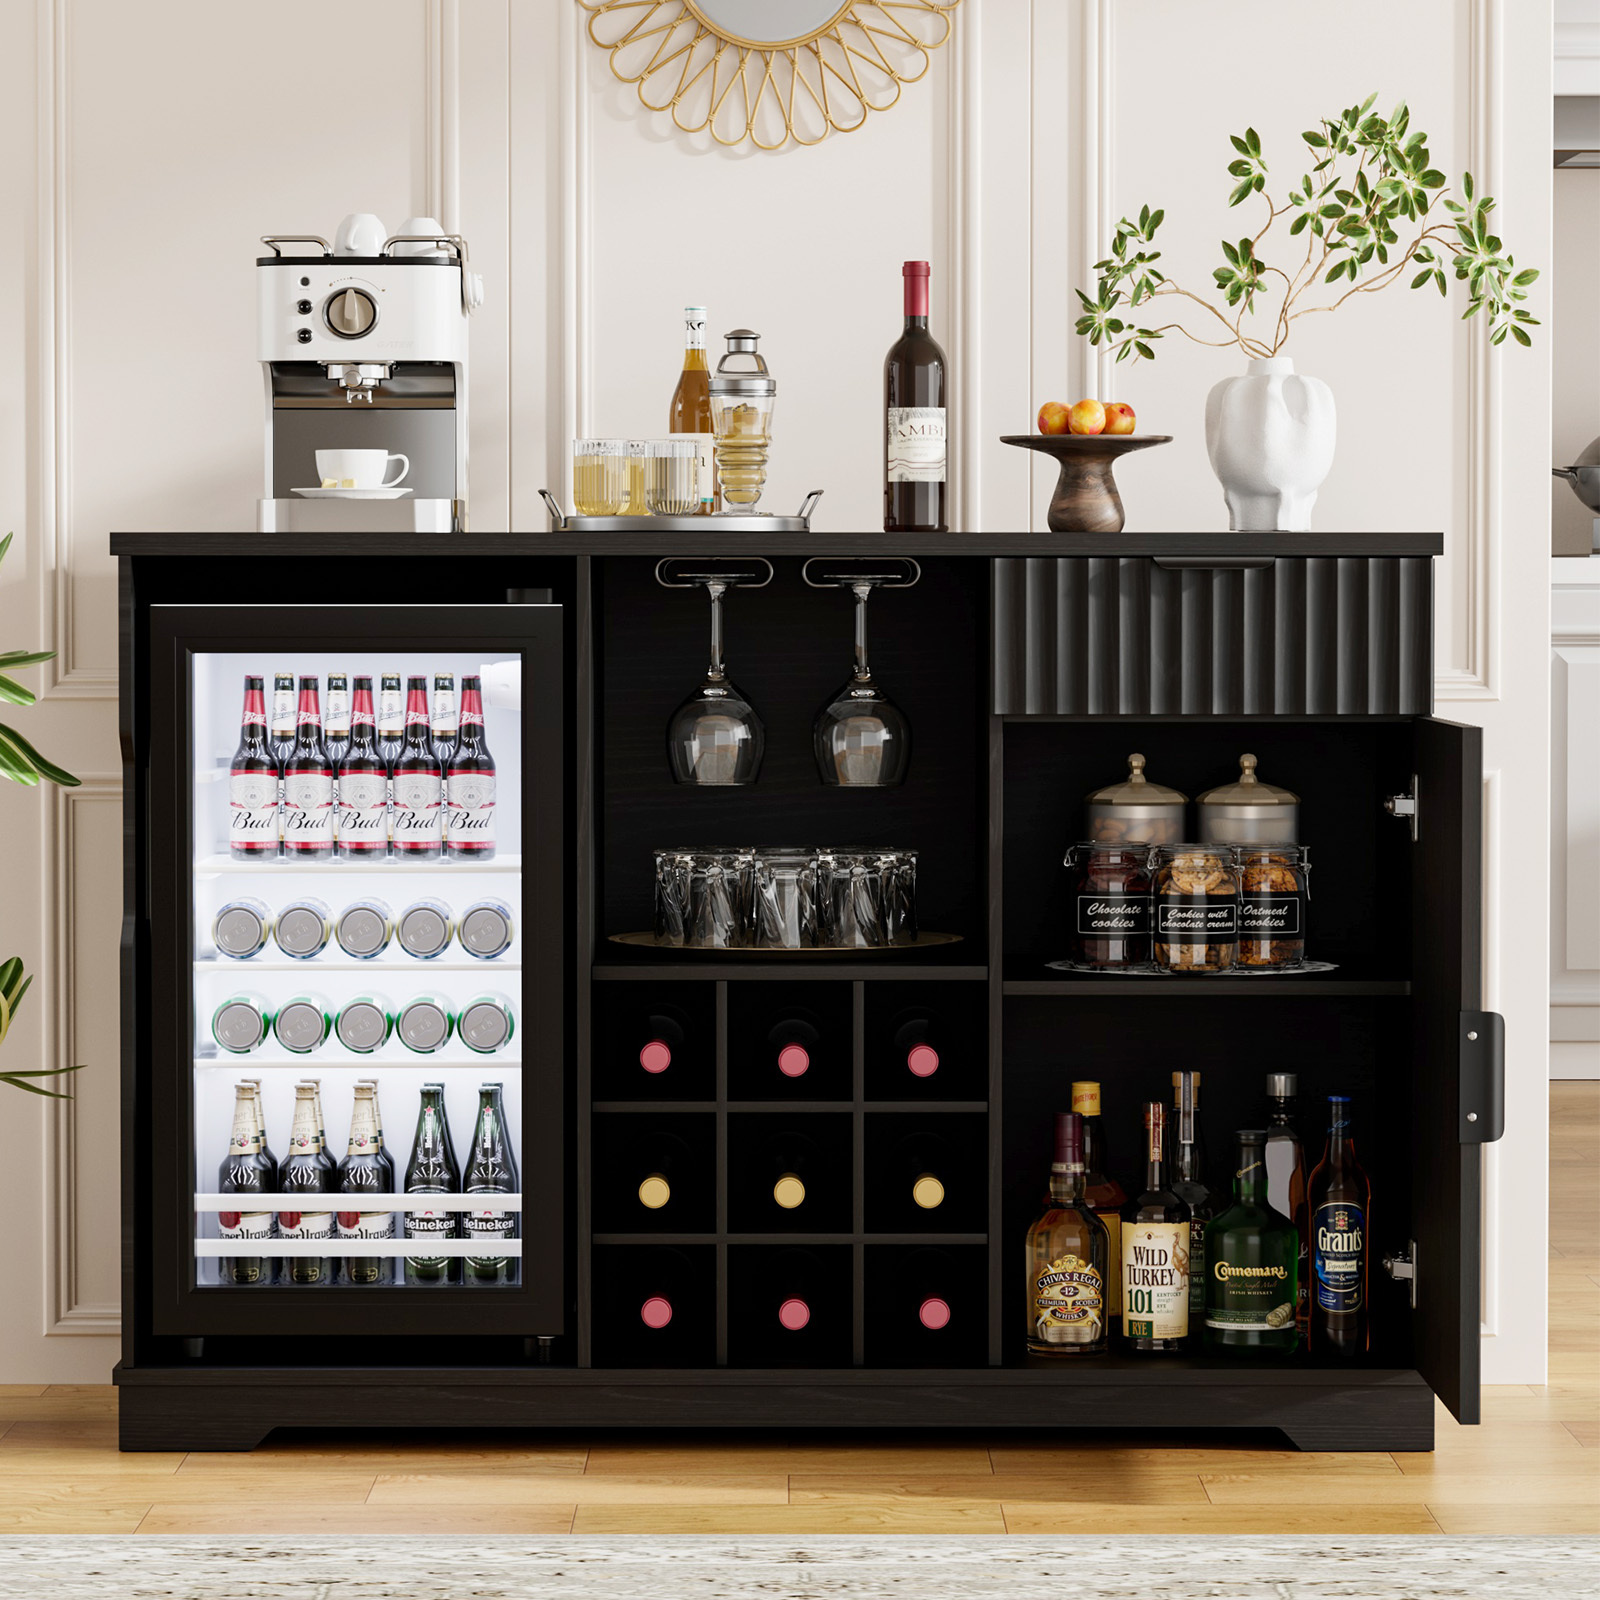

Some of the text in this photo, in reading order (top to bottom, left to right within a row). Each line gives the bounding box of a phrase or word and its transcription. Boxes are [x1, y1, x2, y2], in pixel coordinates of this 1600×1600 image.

[231, 811, 275, 830] Bud
[286, 811, 329, 830] Bud
[341, 811, 384, 830] Bud
[395, 811, 438, 830] Bud
[449, 811, 492, 830] Bud
[1087, 902, 1142, 915] Chocolate
[1167, 908, 1228, 919] Cookies with
[1243, 904, 1288, 915] Oatmeal
[1091, 917, 1136, 928] cookies
[1161, 918, 1234, 928] chocolate cream
[1244, 917, 1286, 928] cookies
[404, 1217, 455, 1230] Heineken
[463, 1217, 514, 1230] Heineken
[1318, 1226, 1362, 1252] Grant's
[1133, 1246, 1168, 1266] WILD
[1126, 1264, 1176, 1287] TURKEY
[1214, 1261, 1288, 1281] Connemara
[1038, 1272, 1101, 1289] CHIVAS REGAL
[1064, 1287, 1074, 1295] 12
[1128, 1288, 1154, 1314] 101
[1055, 1311, 1084, 1319] WHISKY
[1132, 1321, 1148, 1336] RYE
